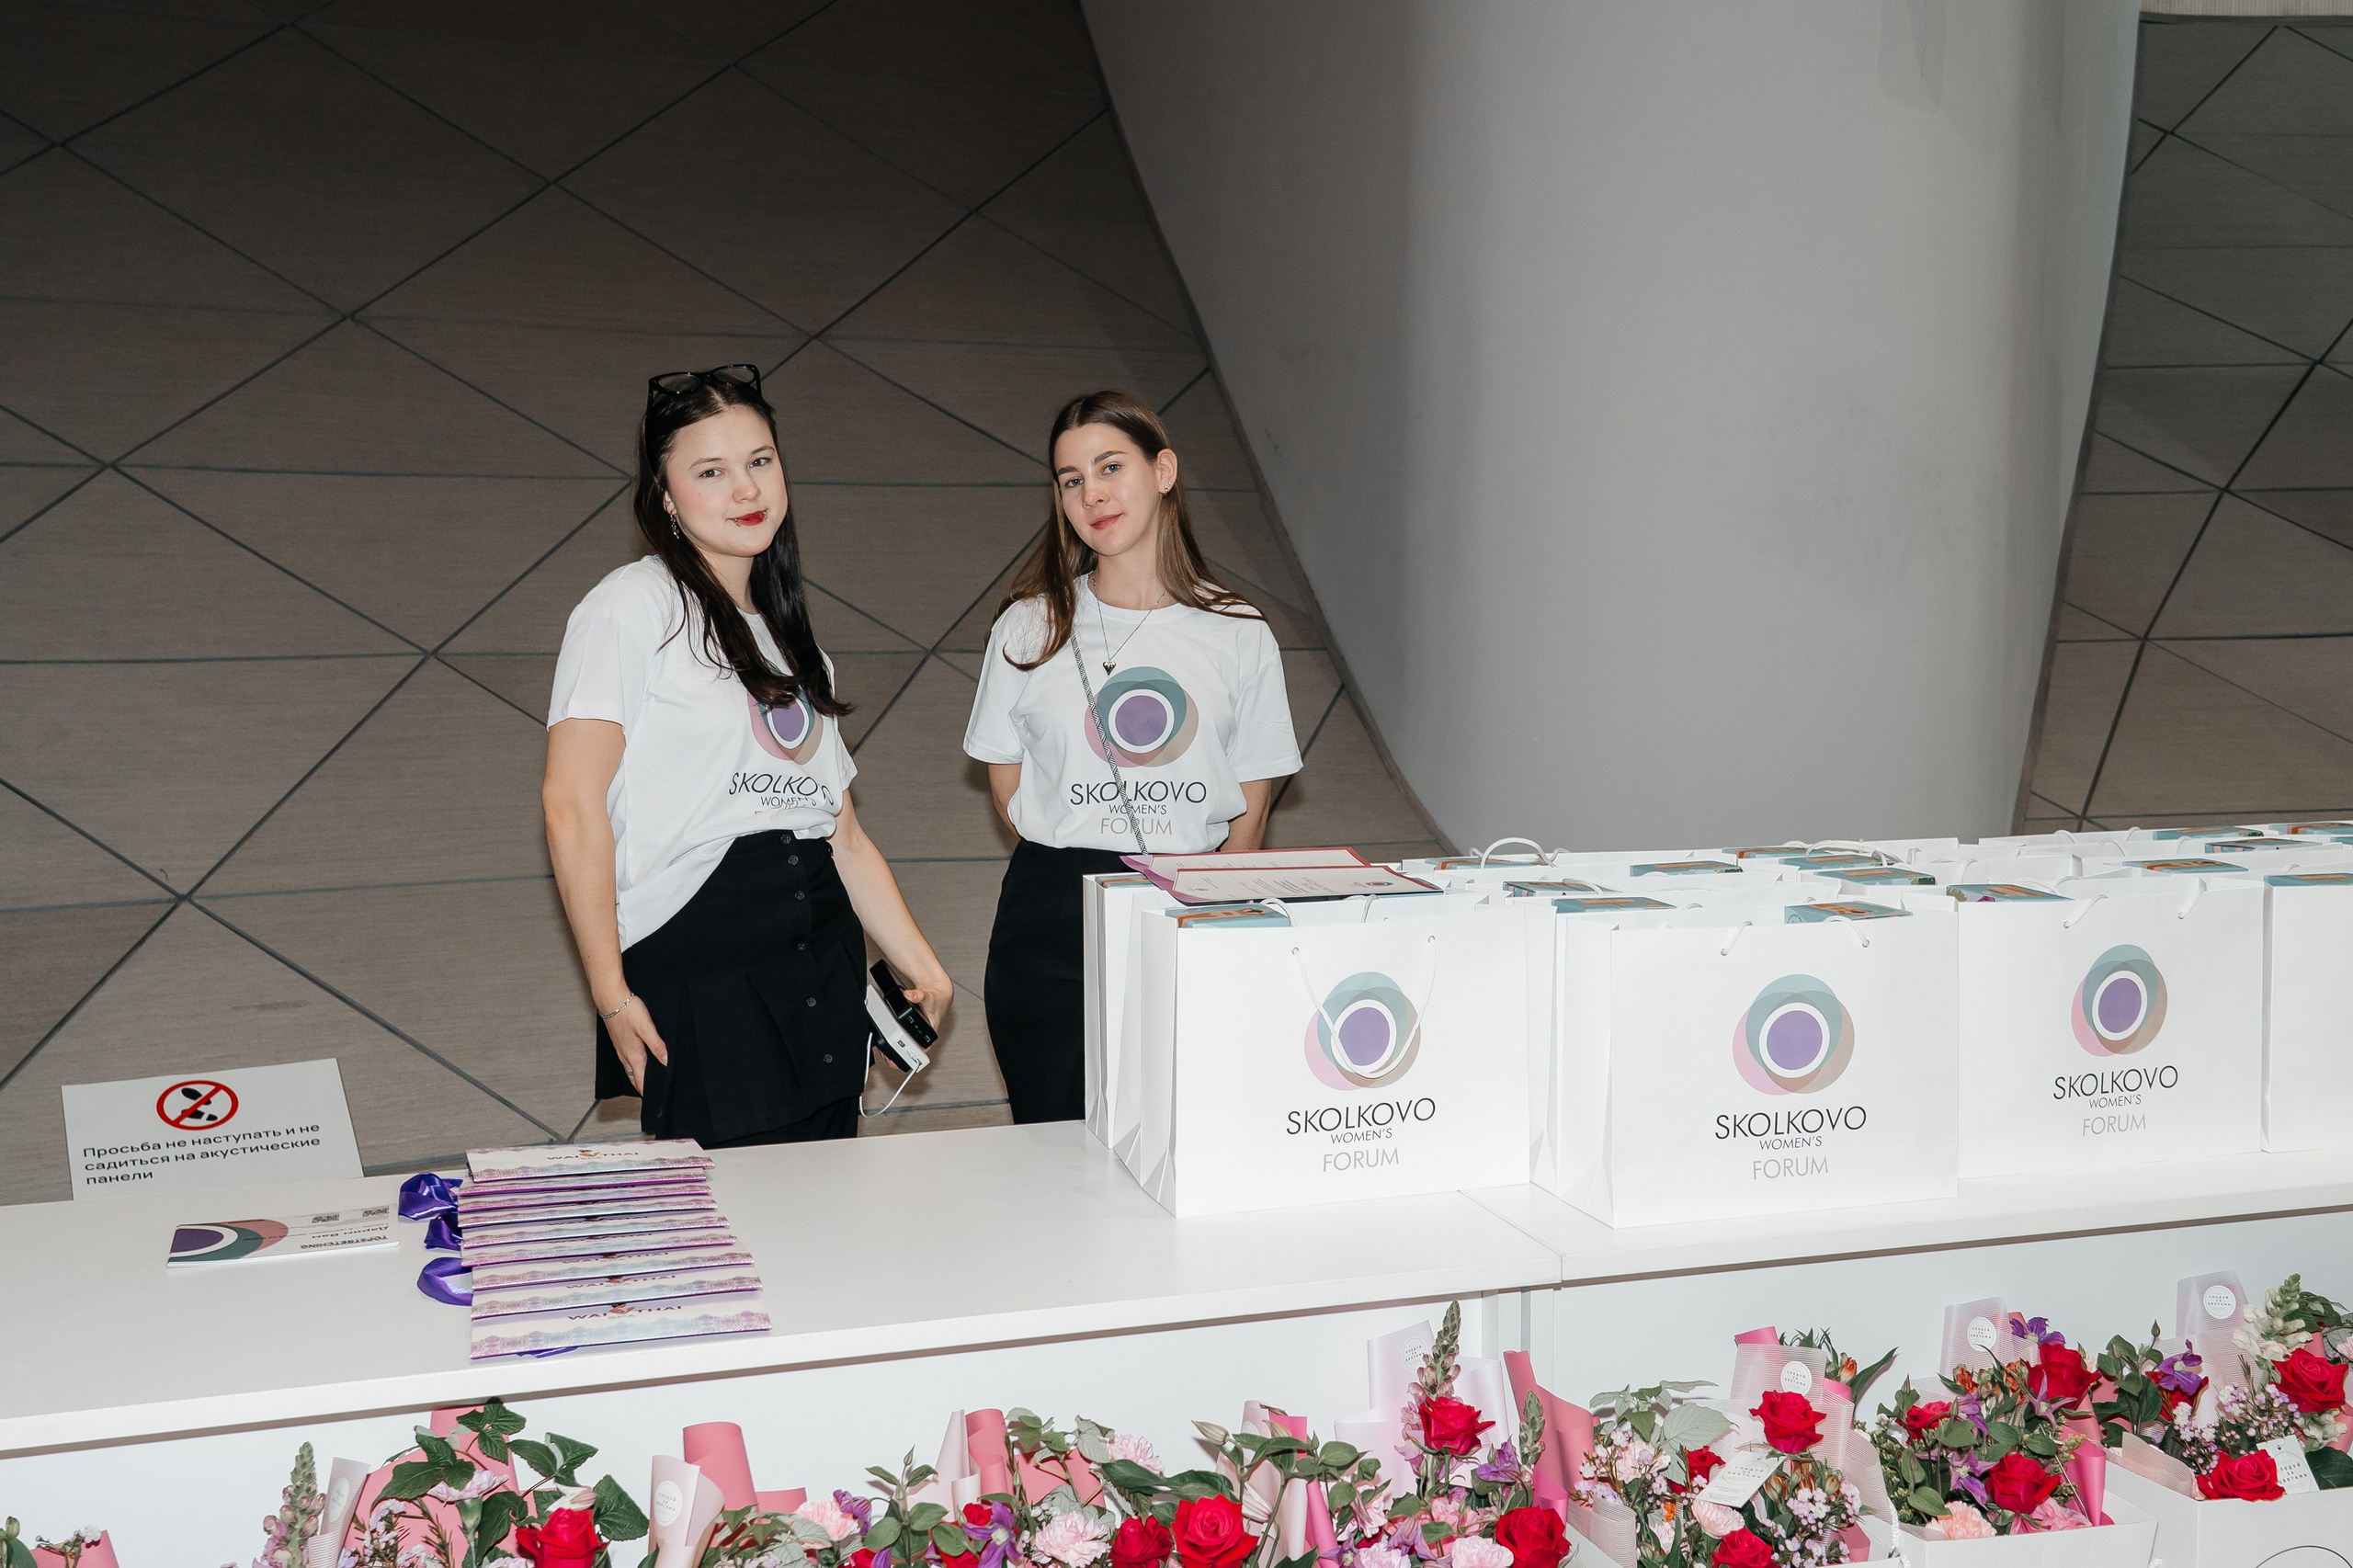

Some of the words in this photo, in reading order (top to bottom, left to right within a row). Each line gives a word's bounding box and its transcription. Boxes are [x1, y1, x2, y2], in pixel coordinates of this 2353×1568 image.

[729, 772, 835, 806] SKOLKOO
[1108, 804, 1167, 815] WOMEN'S
[2052, 1065, 2178, 1100] SKOLKOVO
[2088, 1094, 2142, 1108] WOMEN'S
[1286, 1097, 1436, 1135] SKOLKOVO
[1715, 1106, 1867, 1140] SKOLKOVO
[2082, 1113, 2147, 1136] FORUM
[83, 1142, 162, 1158] Просьба
[165, 1140, 188, 1149] не
[191, 1129, 282, 1146] наступать
[286, 1127, 296, 1135] и
[300, 1124, 321, 1134] не
[1330, 1128, 1392, 1143] WOMEN'S
[1759, 1136, 1823, 1150] WOMEN'S
[85, 1154, 171, 1171] садиться
[175, 1152, 196, 1162] на
[199, 1137, 321, 1159] акустические
[1323, 1147, 1399, 1172] FORUM
[85, 1170, 154, 1185] панели
[1753, 1155, 1828, 1180] FORUM
[2277, 1462, 2302, 1472] ЛЕДУЙ
